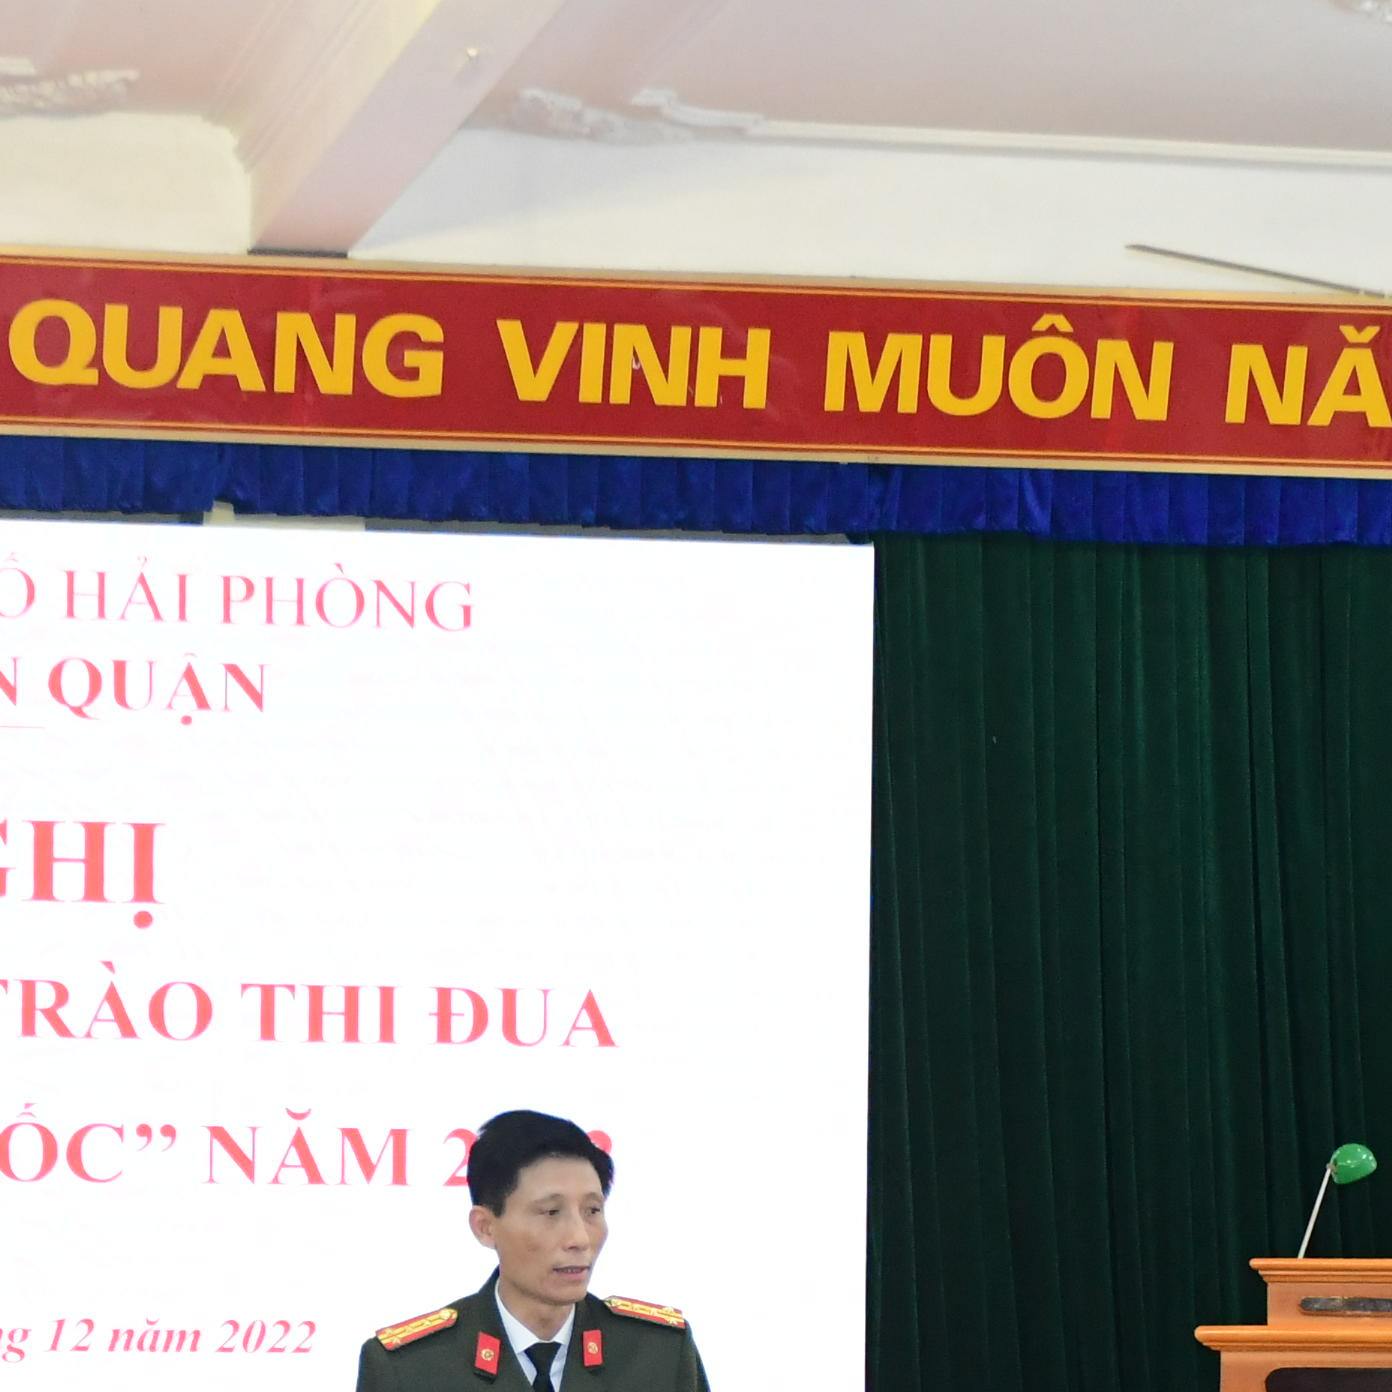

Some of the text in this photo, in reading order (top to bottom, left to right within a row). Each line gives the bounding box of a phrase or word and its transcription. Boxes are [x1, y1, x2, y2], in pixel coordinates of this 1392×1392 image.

[8, 299, 445, 398] QUANG
[495, 319, 771, 409] VINH
[824, 313, 1174, 421] MUÔN
[63, 554, 190, 623] HẢI
[219, 562, 474, 632] PHÒNG
[46, 651, 267, 727] QUẬN
[239, 982, 398, 1045] THI
[427, 986, 620, 1048] ĐUA
[204, 1108, 411, 1187] NĂM
[43, 1317, 96, 1353] 12
[106, 1319, 203, 1353] năm
[214, 1319, 318, 1354] 2022
